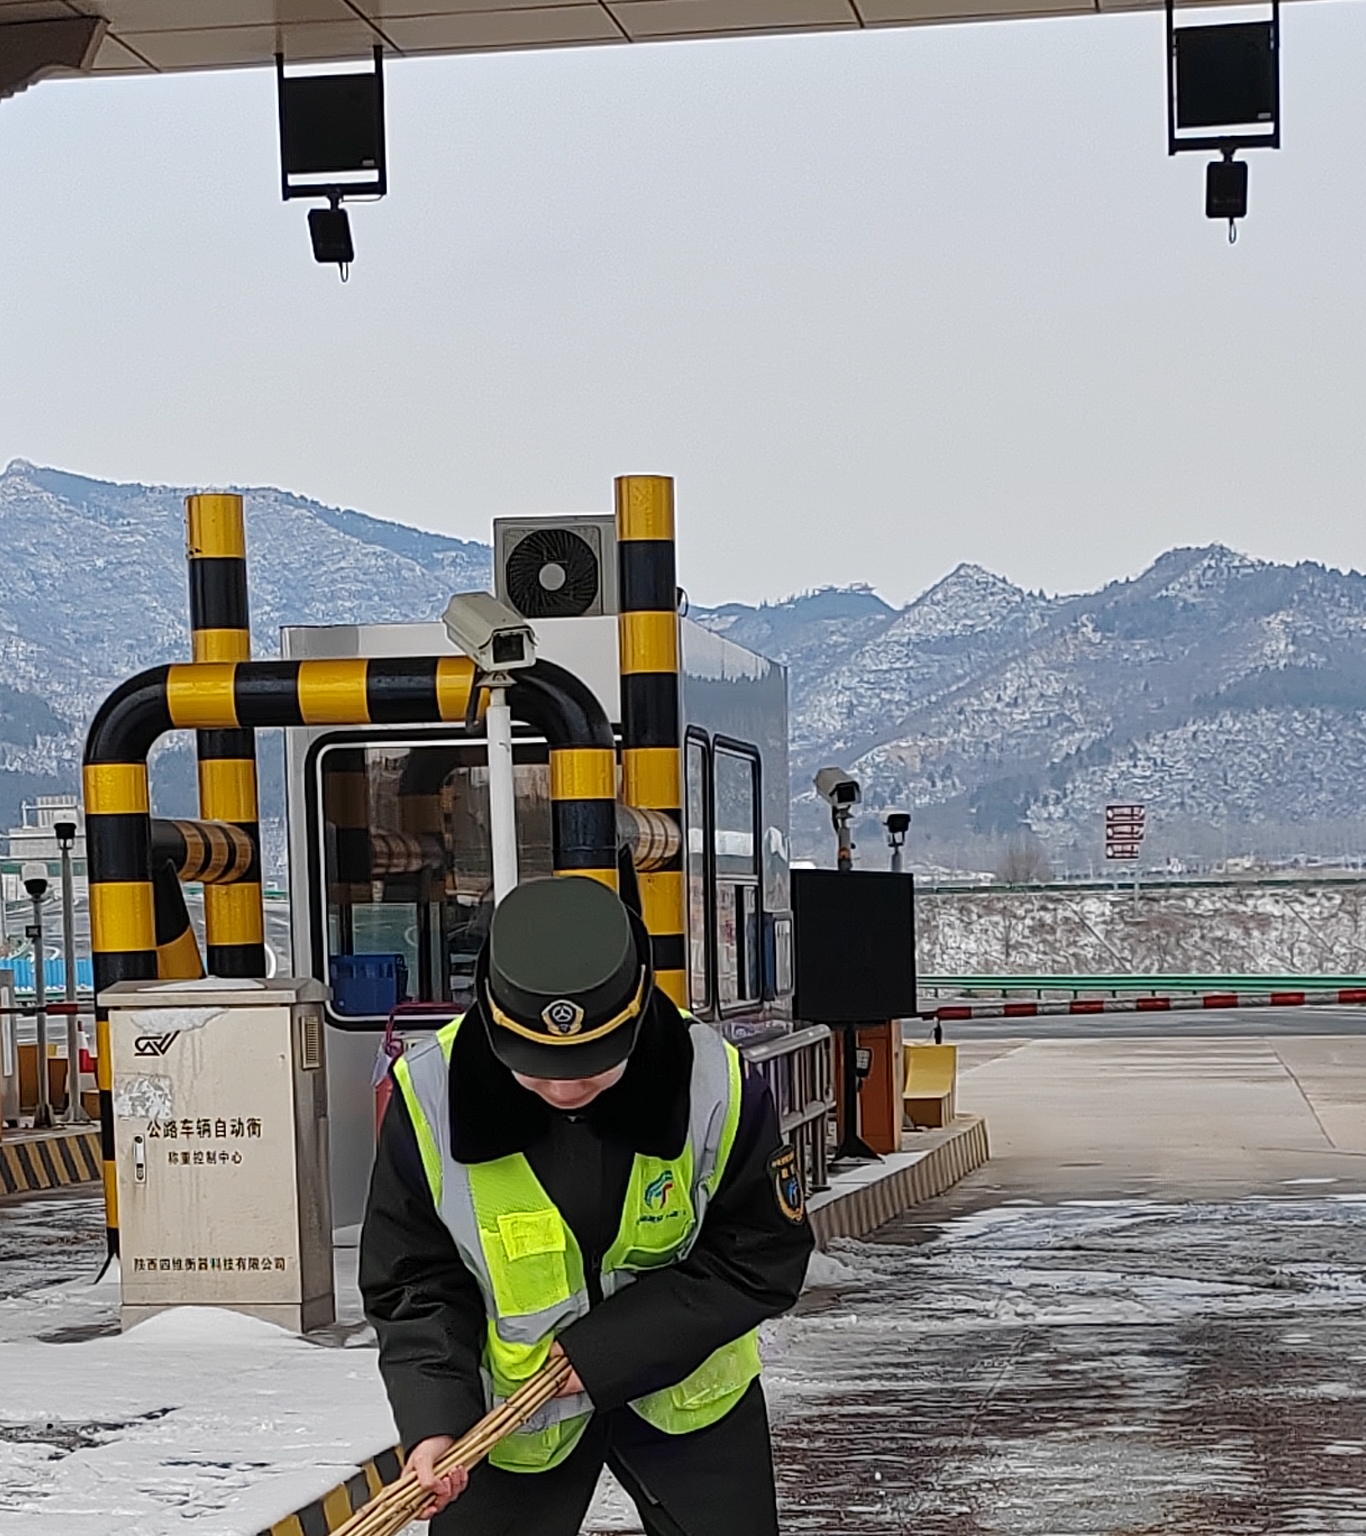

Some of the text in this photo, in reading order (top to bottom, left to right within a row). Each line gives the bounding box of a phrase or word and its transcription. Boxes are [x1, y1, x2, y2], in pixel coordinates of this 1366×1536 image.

[147, 1117, 262, 1139] 公路车辆自动衡
[168, 1150, 243, 1165] 称重控制中心
[134, 1256, 286, 1271] 陕西四维衡器科技有限公司
